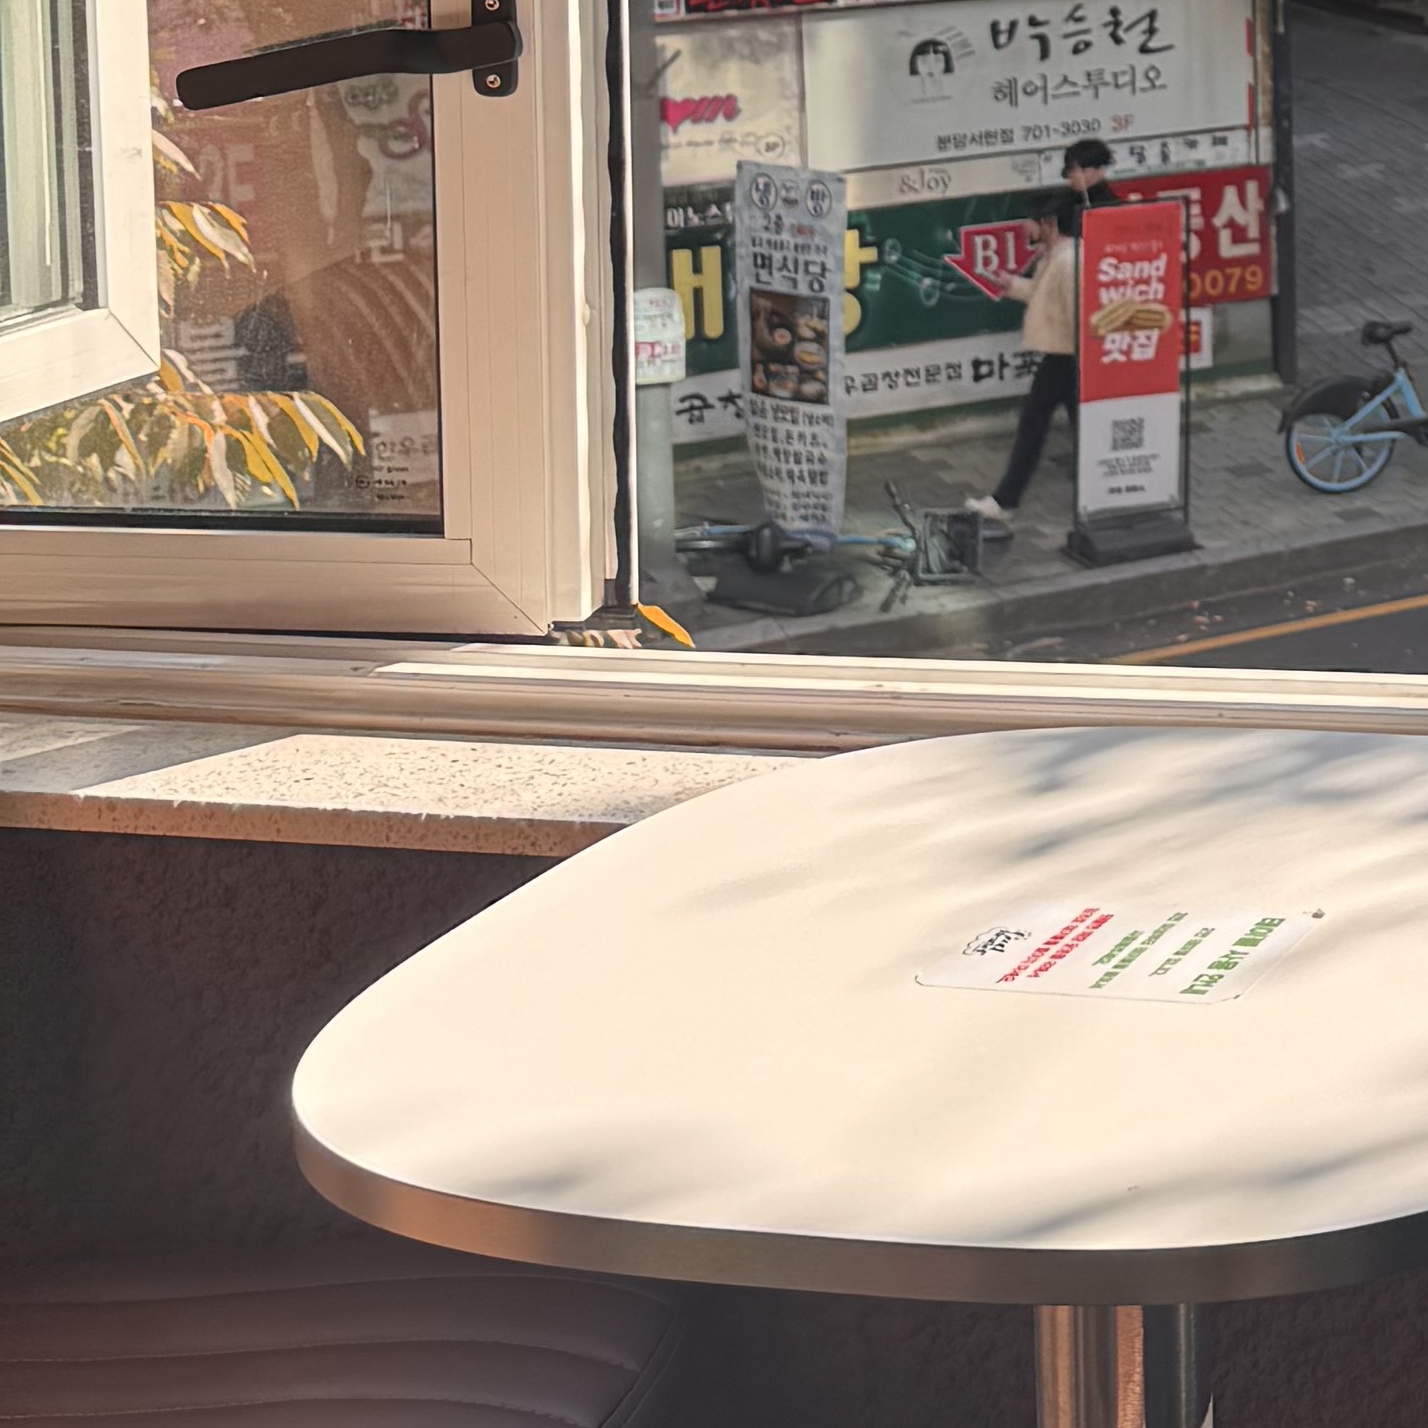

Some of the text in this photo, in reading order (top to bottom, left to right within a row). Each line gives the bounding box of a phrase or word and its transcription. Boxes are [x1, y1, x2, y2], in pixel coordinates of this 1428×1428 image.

[988, 2, 1177, 63] 박승철
[992, 63, 1168, 109] 헤어스투디오
[1021, 117, 1102, 141] 701-3030
[1110, 114, 1134, 133] 3F
[1097, 253, 1168, 282] Sand
[1099, 276, 1165, 304] wich
[1101, 330, 1160, 363] 맛집
